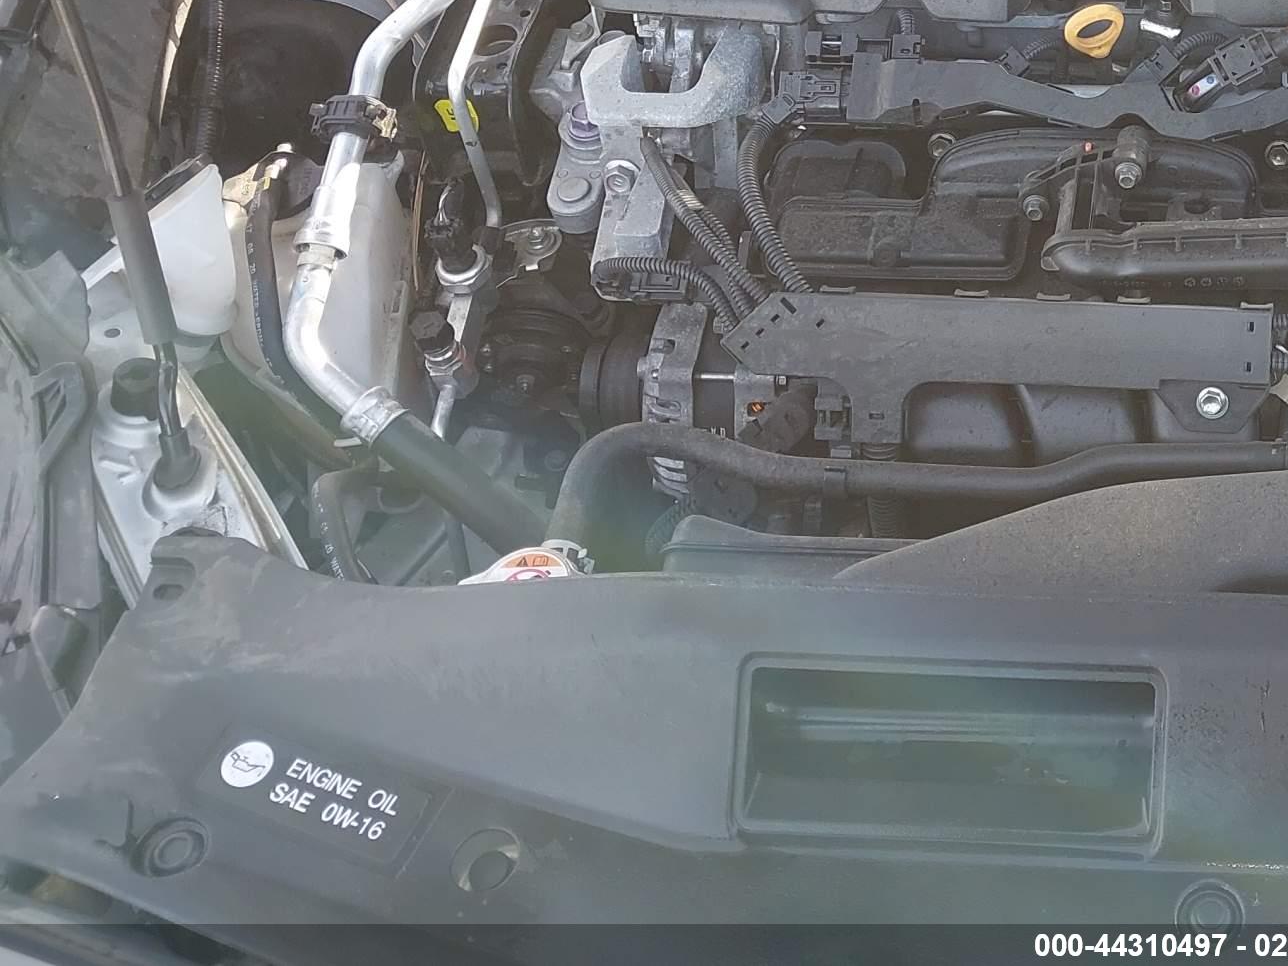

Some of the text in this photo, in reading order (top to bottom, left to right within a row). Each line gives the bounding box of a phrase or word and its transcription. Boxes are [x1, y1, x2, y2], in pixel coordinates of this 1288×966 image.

[269, 782, 386, 841] SAE 0W-16
[286, 758, 399, 816] ENGINE OIL
